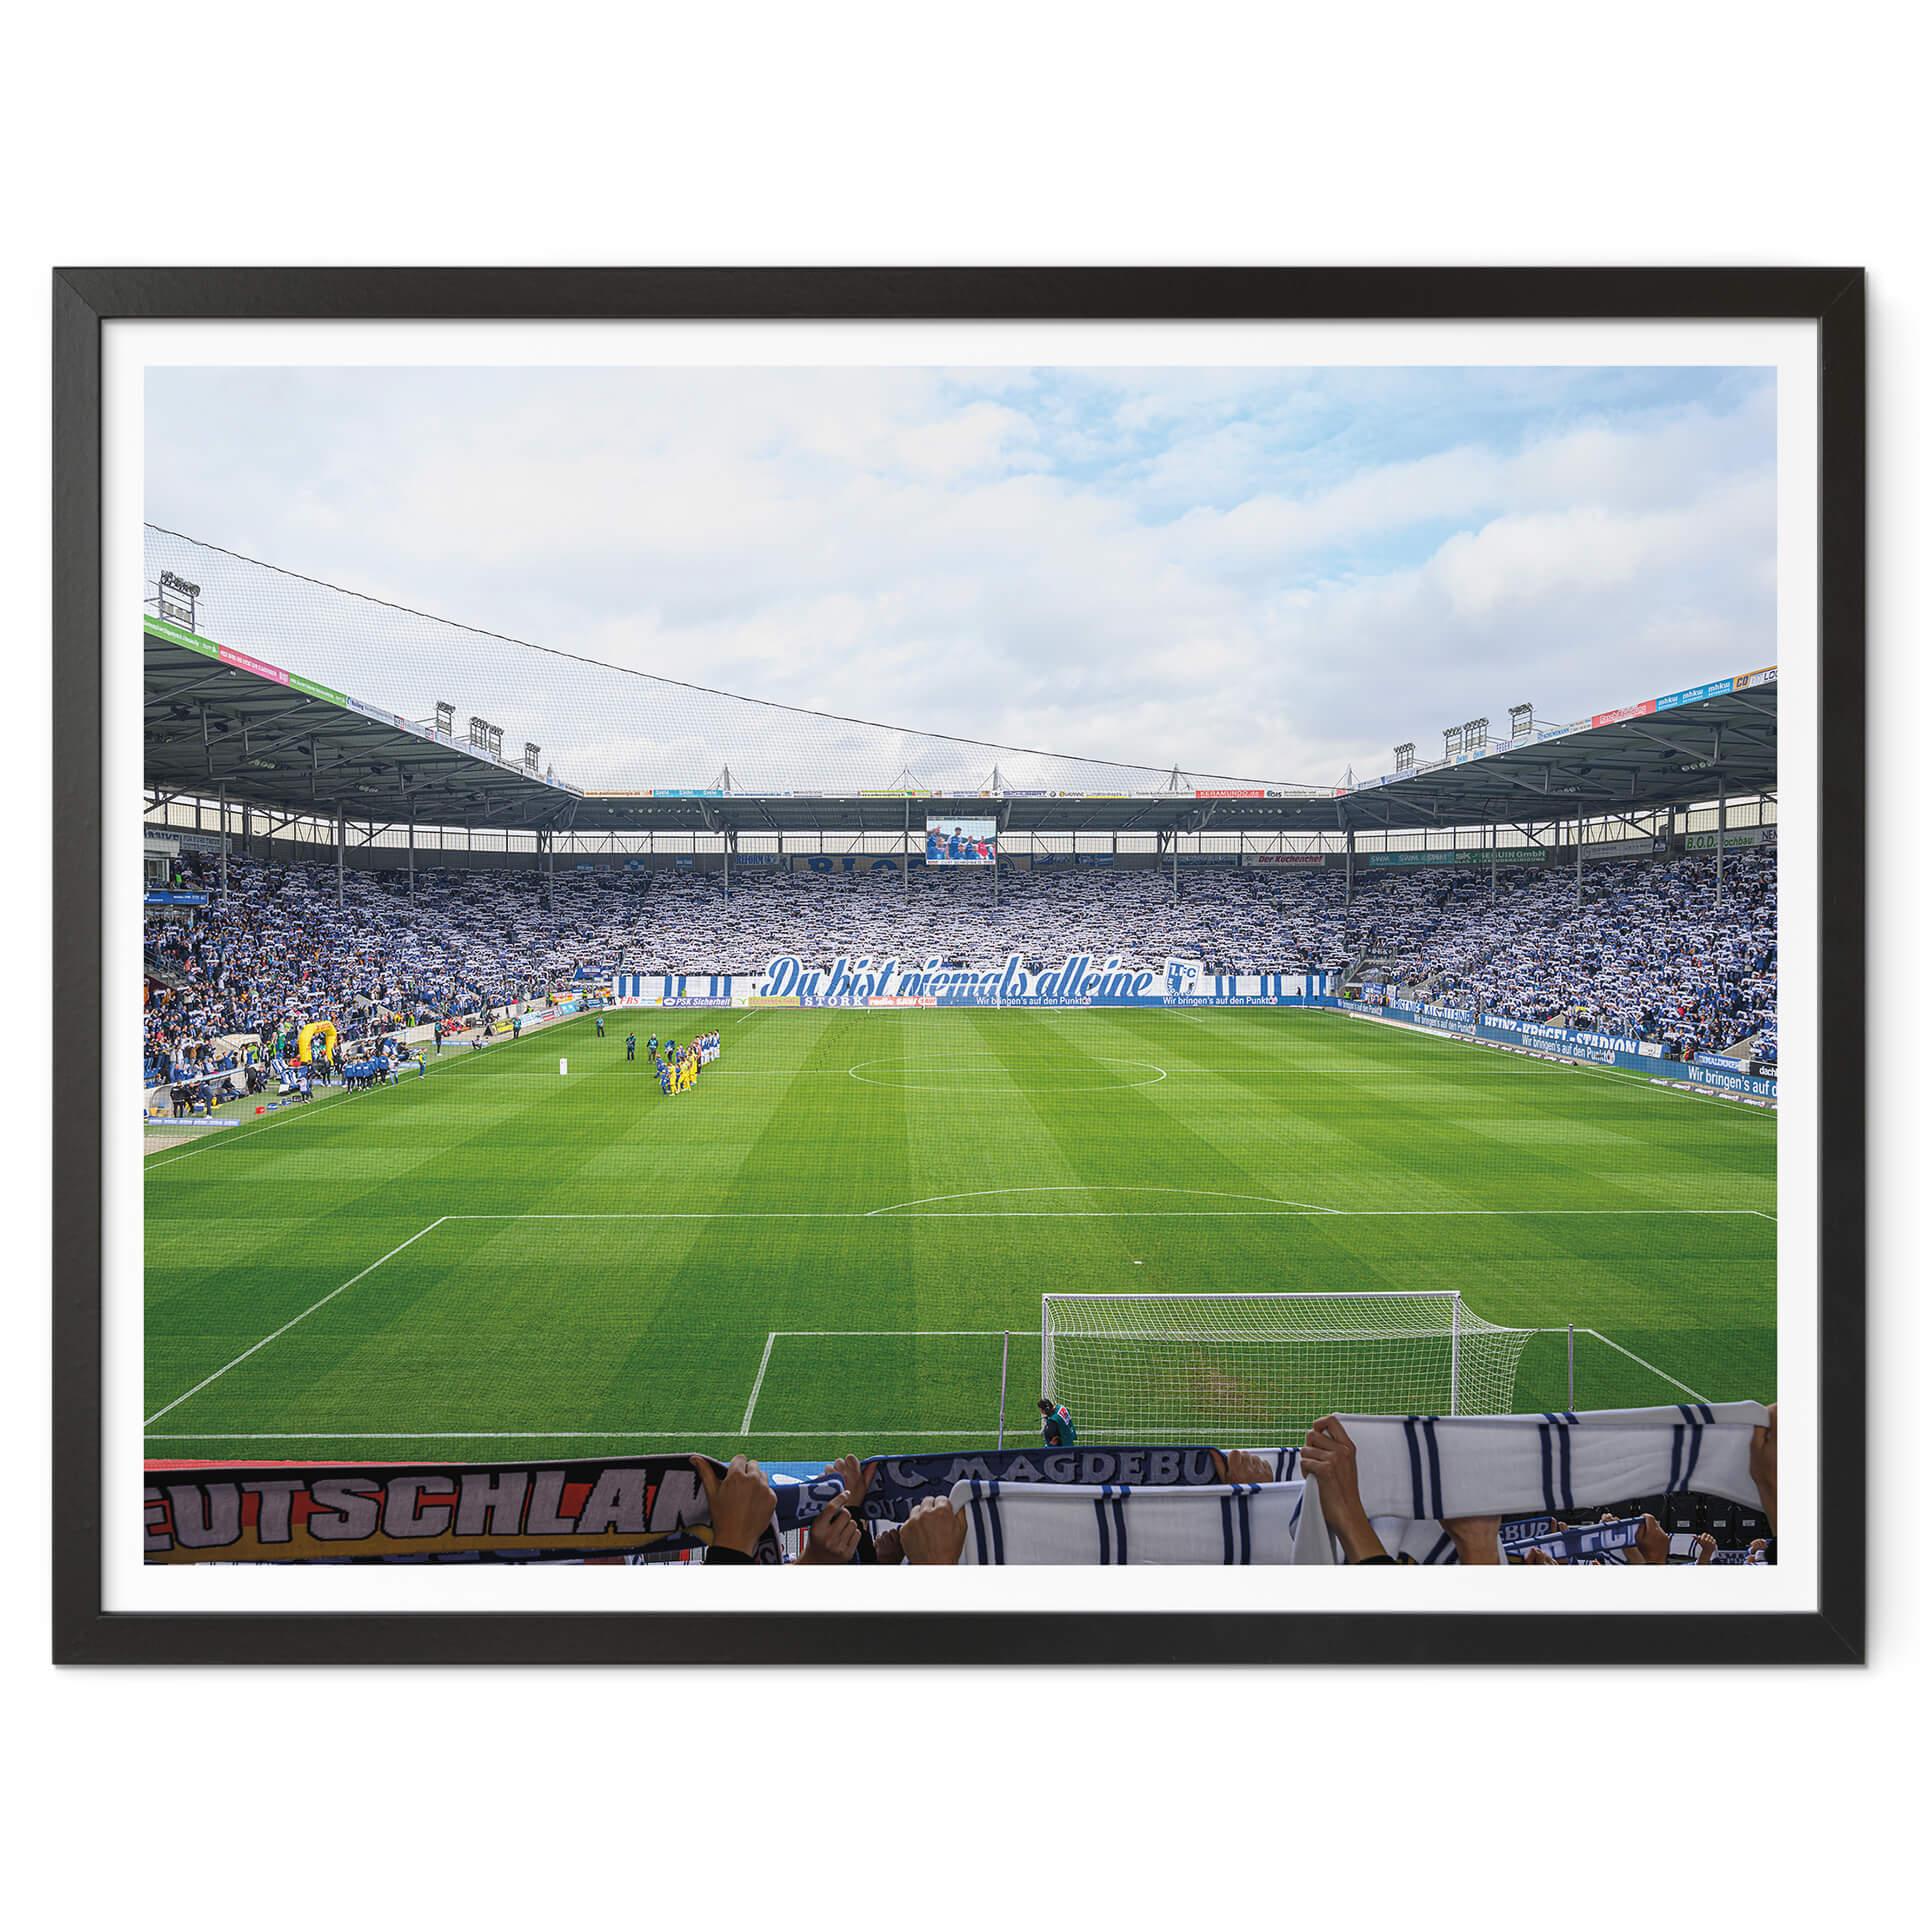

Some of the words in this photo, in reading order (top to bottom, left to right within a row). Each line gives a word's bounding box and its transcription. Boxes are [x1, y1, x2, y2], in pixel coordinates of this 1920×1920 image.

[1516, 850, 1545, 858] GmbH
[760, 956, 821, 997] Du
[825, 958, 897, 997] bist
[898, 955, 1028, 997] niemals
[1035, 955, 1154, 997] alleine
[805, 996, 864, 1007] STORK
[976, 997, 989, 1005] Wir
[1029, 996, 1041, 1005] auf
[1043, 996, 1058, 1005] den
[1163, 997, 1176, 1005] Wir
[1178, 996, 1213, 1007] bringen's
[1216, 996, 1228, 1005] auf
[1230, 996, 1244, 1005] den
[1522, 1034, 1531, 1046] Wir
[1533, 1036, 1560, 1052] bringen's
[1562, 1043, 1572, 1055] auf
[1574, 1046, 1585, 1058] den
[1688, 1065, 1704, 1081] Wir
[1706, 1068, 1750, 1092] bringen's
[1752, 1080, 1770, 1096] auf
